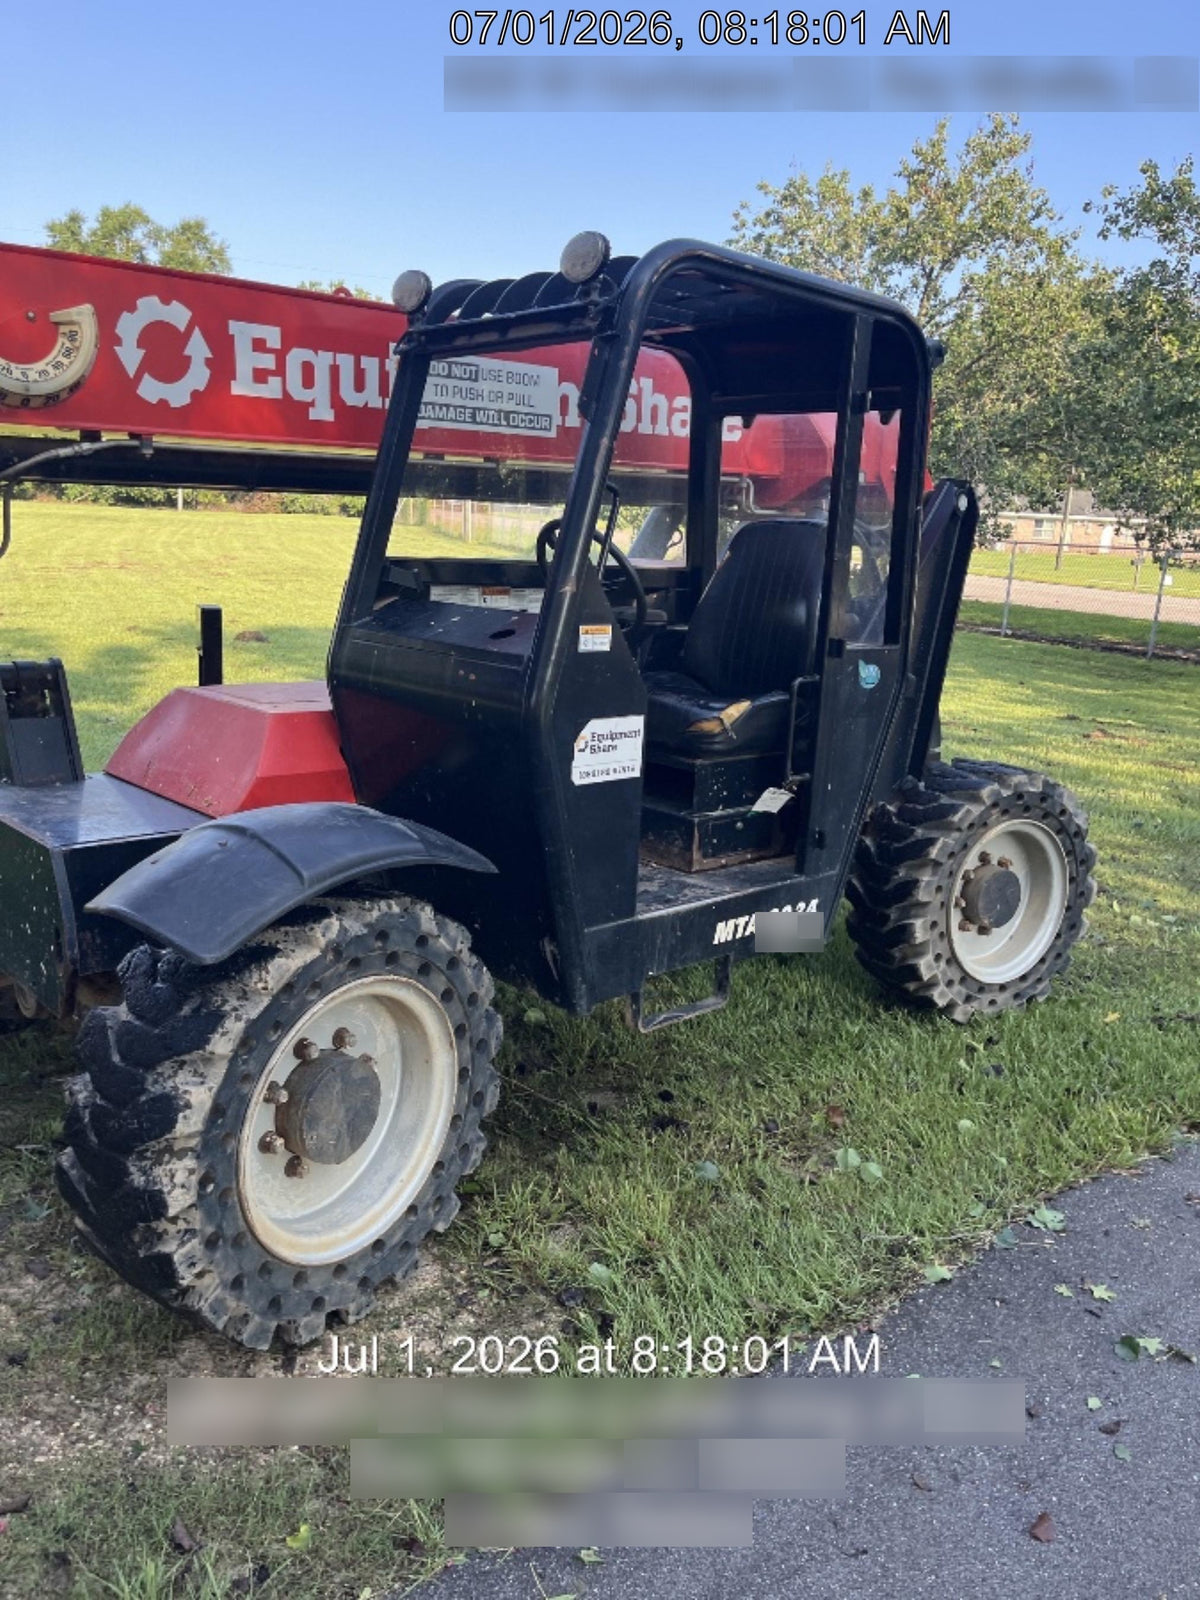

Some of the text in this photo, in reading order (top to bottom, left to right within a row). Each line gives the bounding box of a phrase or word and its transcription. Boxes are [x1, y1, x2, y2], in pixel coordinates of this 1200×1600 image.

[429, 362, 541, 387] DO NOT USE BOOM
[432, 383, 535, 408] TO PUSH OR PULL
[476, 409, 508, 426] WILL
[509, 413, 550, 430] OCCUR
[590, 728, 641, 743] Equipment
[589, 743, 618, 754] Share
